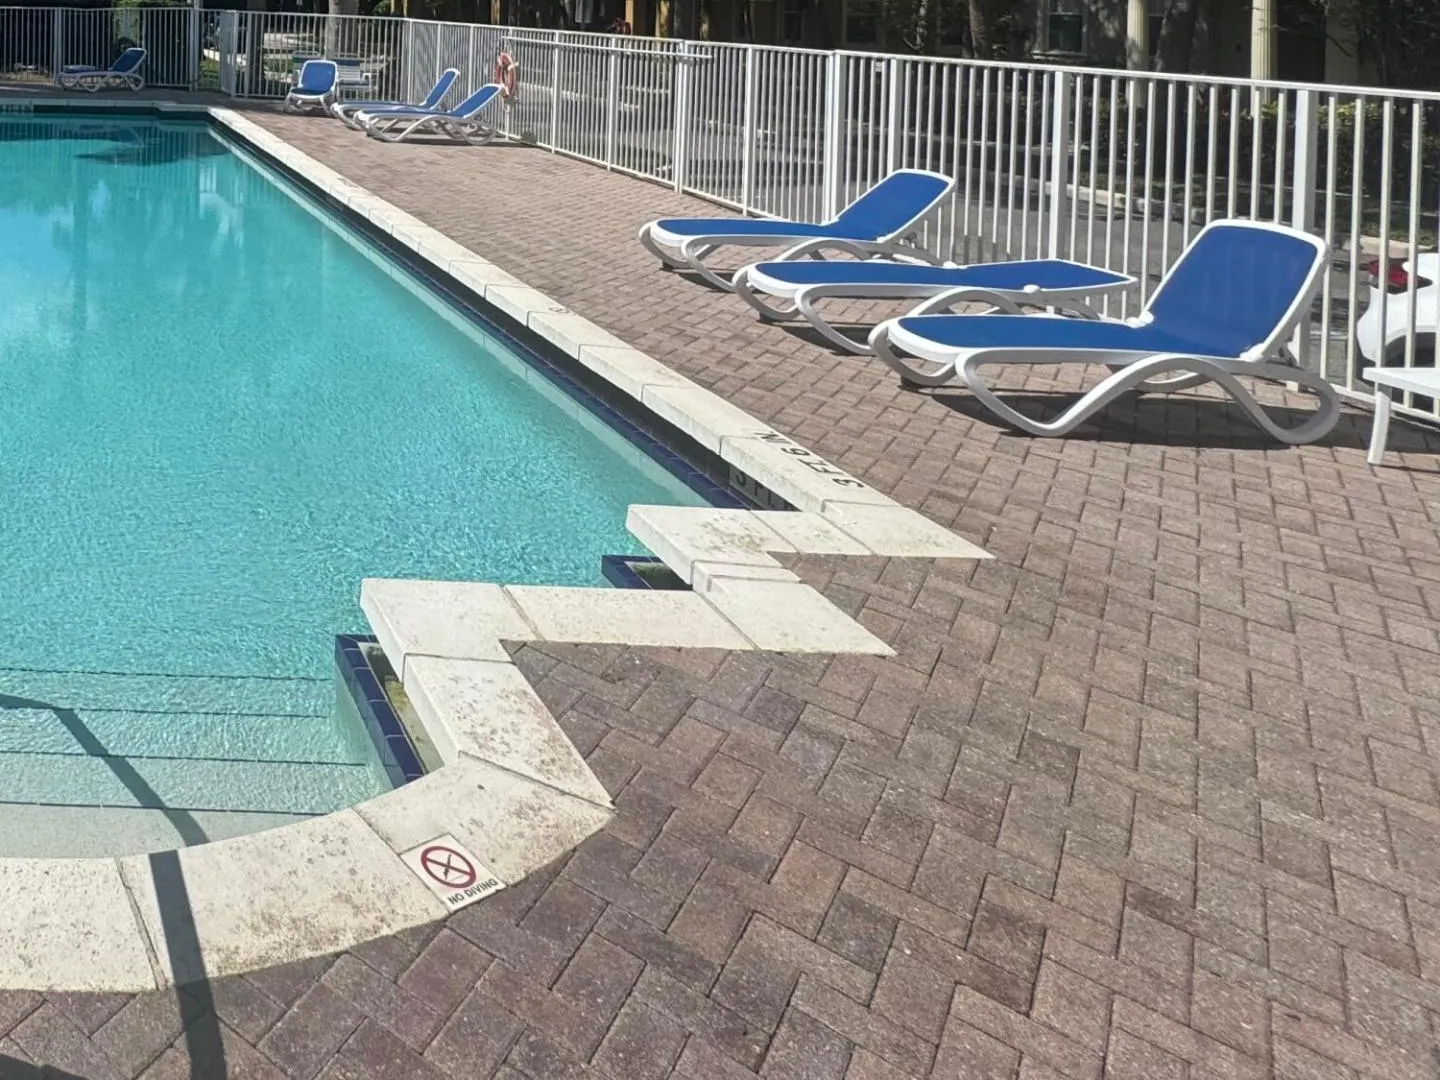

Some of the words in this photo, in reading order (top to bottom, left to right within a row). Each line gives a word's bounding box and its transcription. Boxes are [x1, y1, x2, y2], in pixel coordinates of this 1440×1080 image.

[781, 447, 810, 456] 6
[832, 478, 864, 488] 3
[448, 894, 464, 904] NO
[464, 878, 498, 896] DIVING
